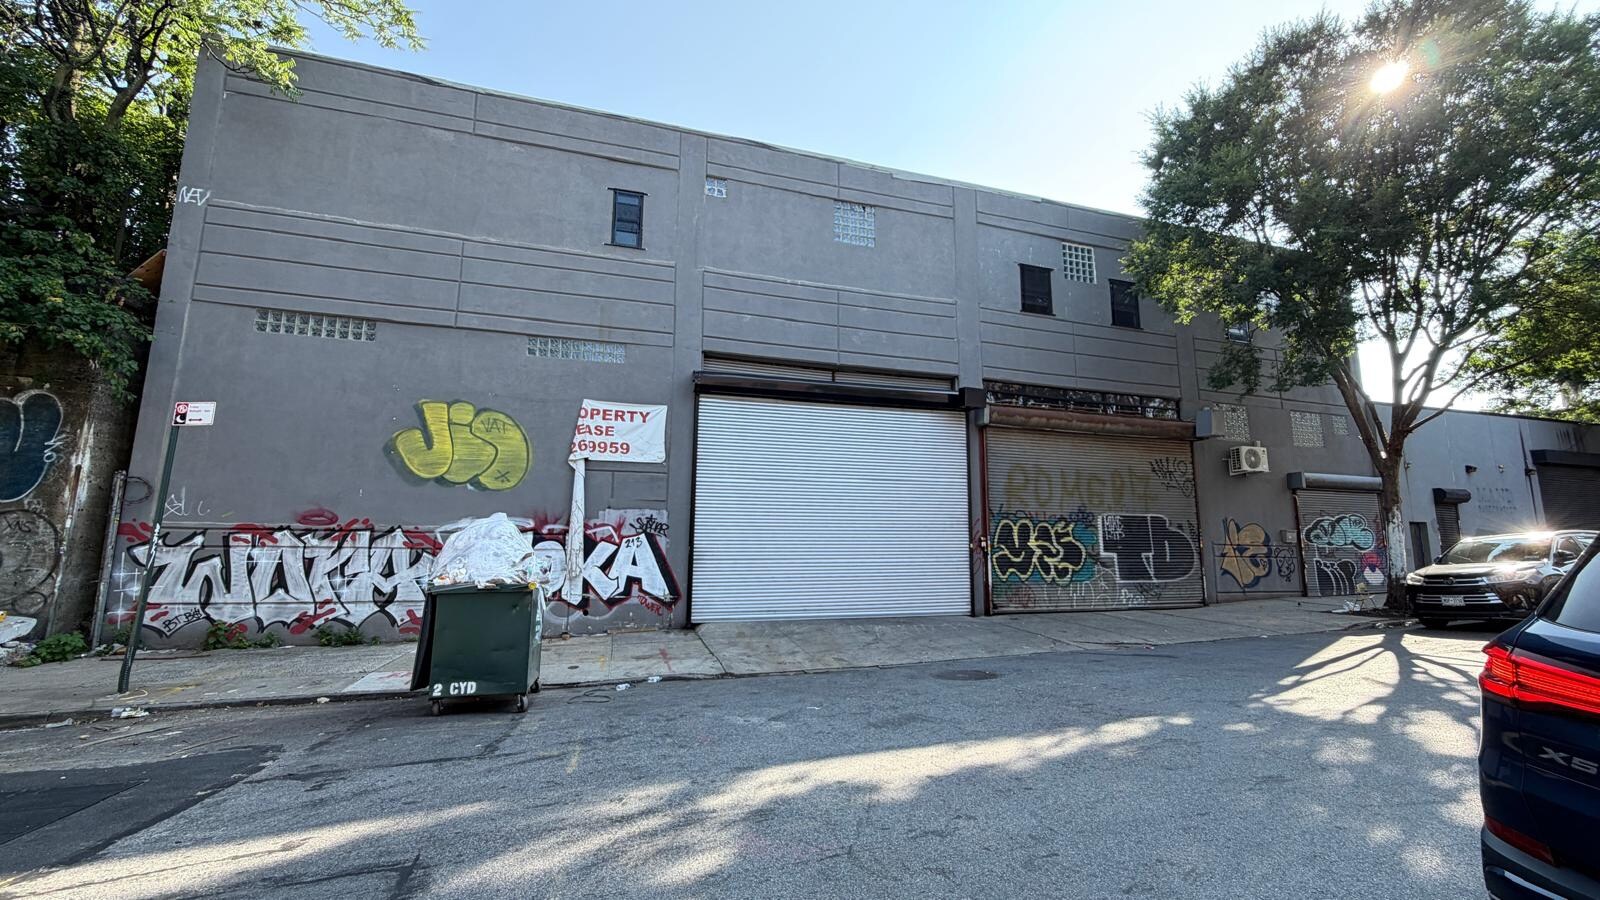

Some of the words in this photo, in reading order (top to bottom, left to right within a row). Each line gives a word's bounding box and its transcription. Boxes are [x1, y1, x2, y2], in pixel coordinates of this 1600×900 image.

[432, 683, 443, 697] 2
[449, 681, 477, 695] CYD
[1538, 745, 1599, 775] X5
